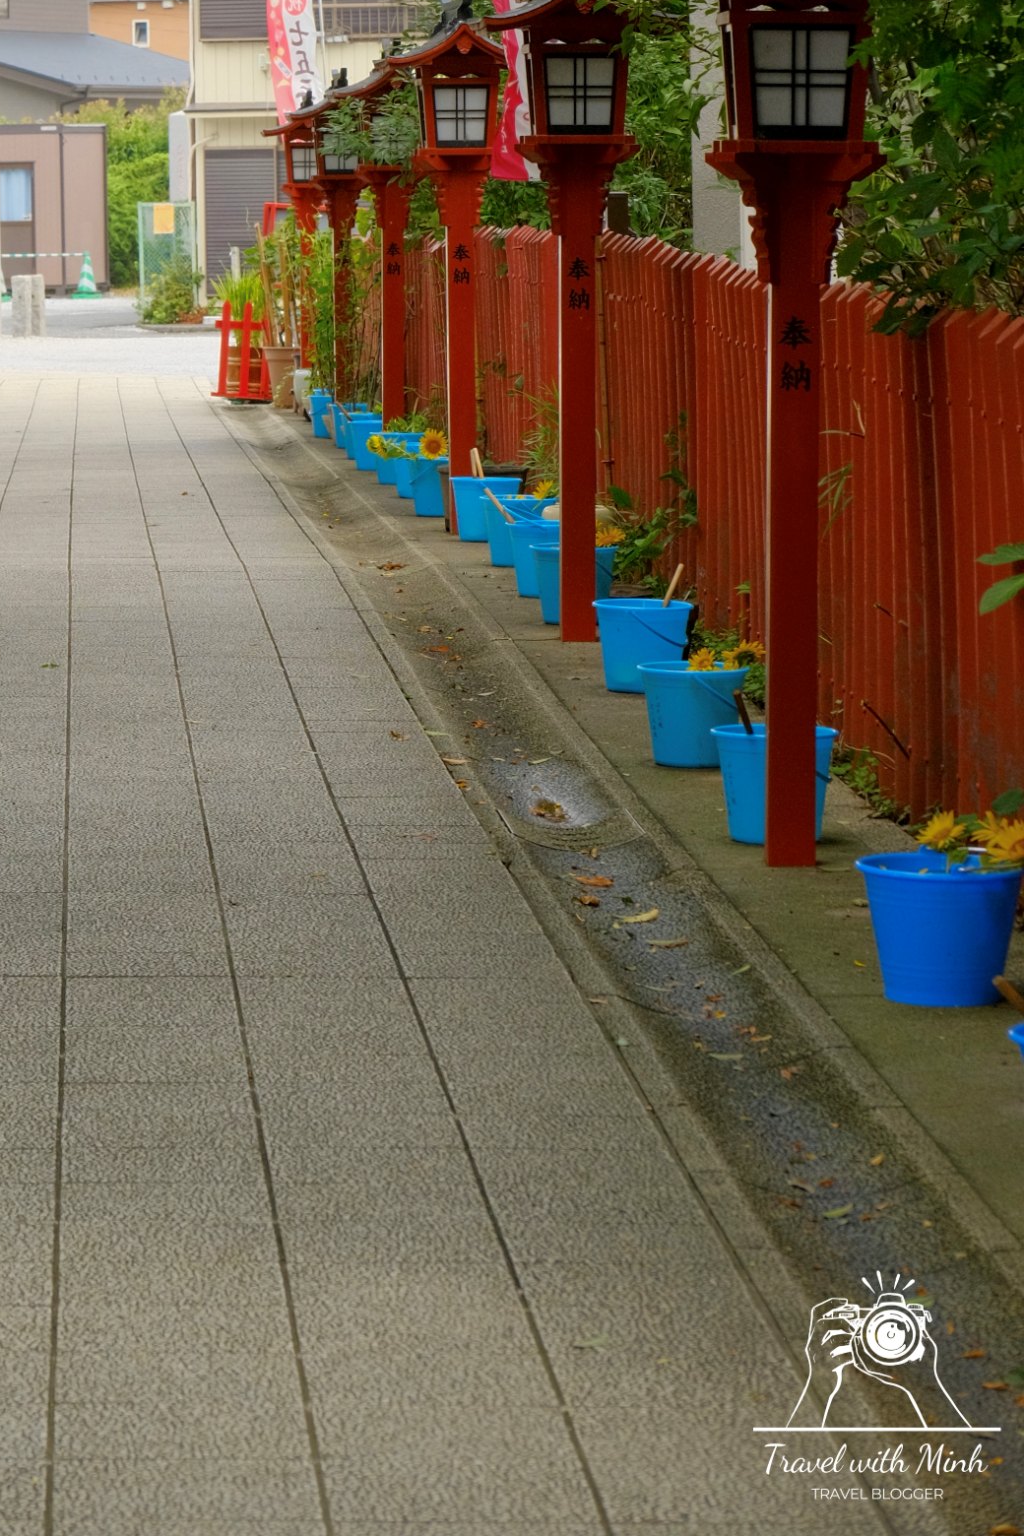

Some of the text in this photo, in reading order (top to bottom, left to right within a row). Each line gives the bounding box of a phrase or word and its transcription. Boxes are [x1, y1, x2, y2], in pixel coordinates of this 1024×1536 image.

[386, 242, 401, 276] 奉納
[453, 243, 470, 285] 奉納
[568, 256, 590, 311] 奉納
[779, 315, 813, 391] 奉納
